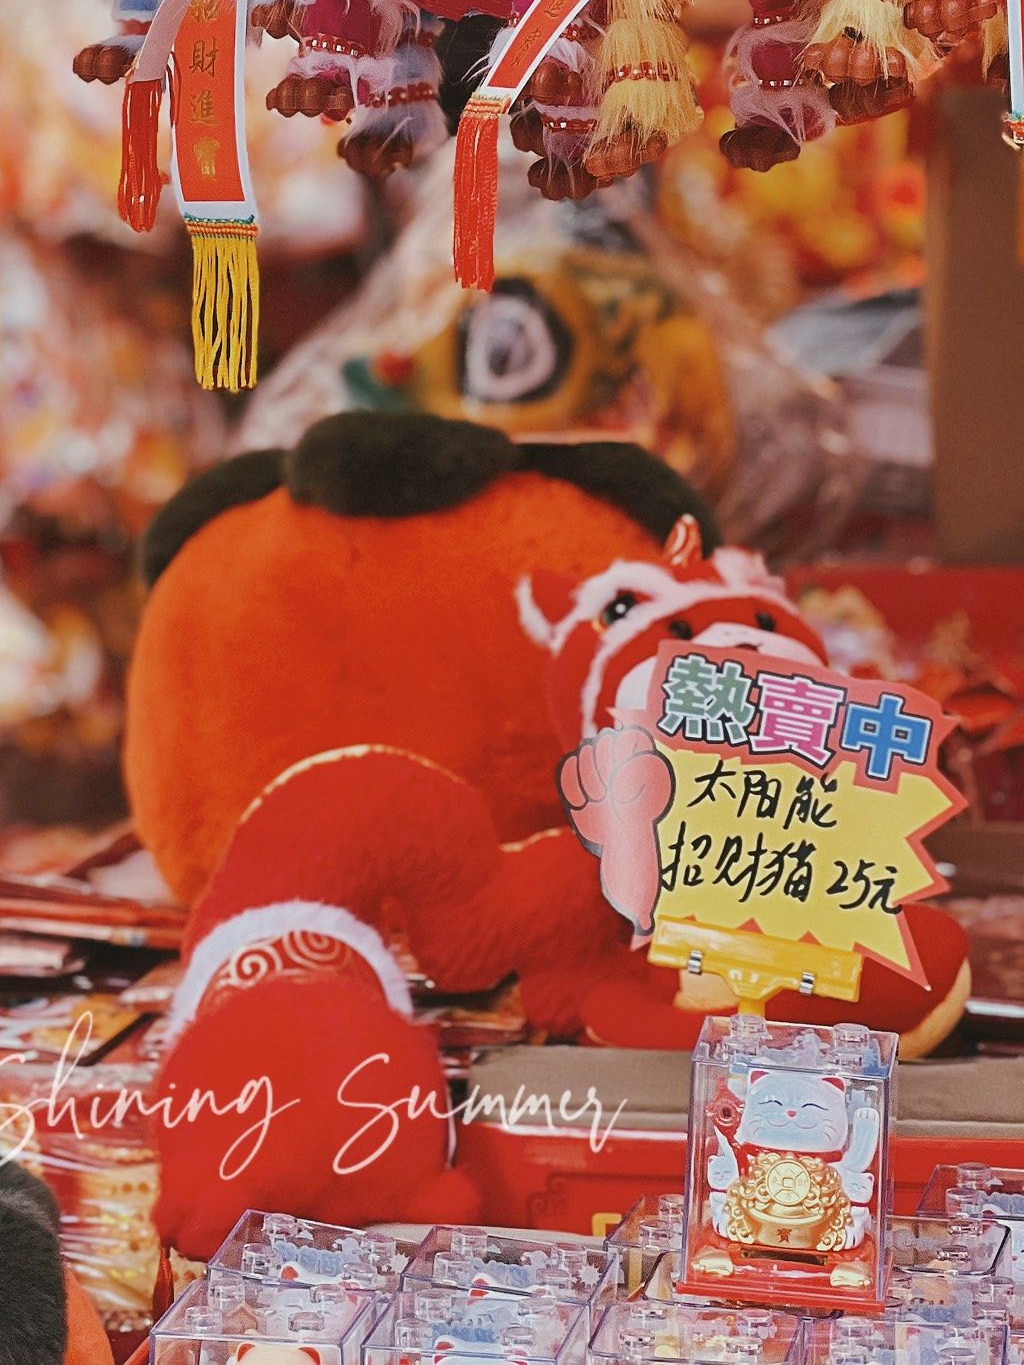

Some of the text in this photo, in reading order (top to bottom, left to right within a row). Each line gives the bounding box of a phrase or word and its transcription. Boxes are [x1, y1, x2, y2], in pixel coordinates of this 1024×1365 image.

[658, 653, 933, 781] 熱賣中
[687, 759, 838, 830] 太阳能
